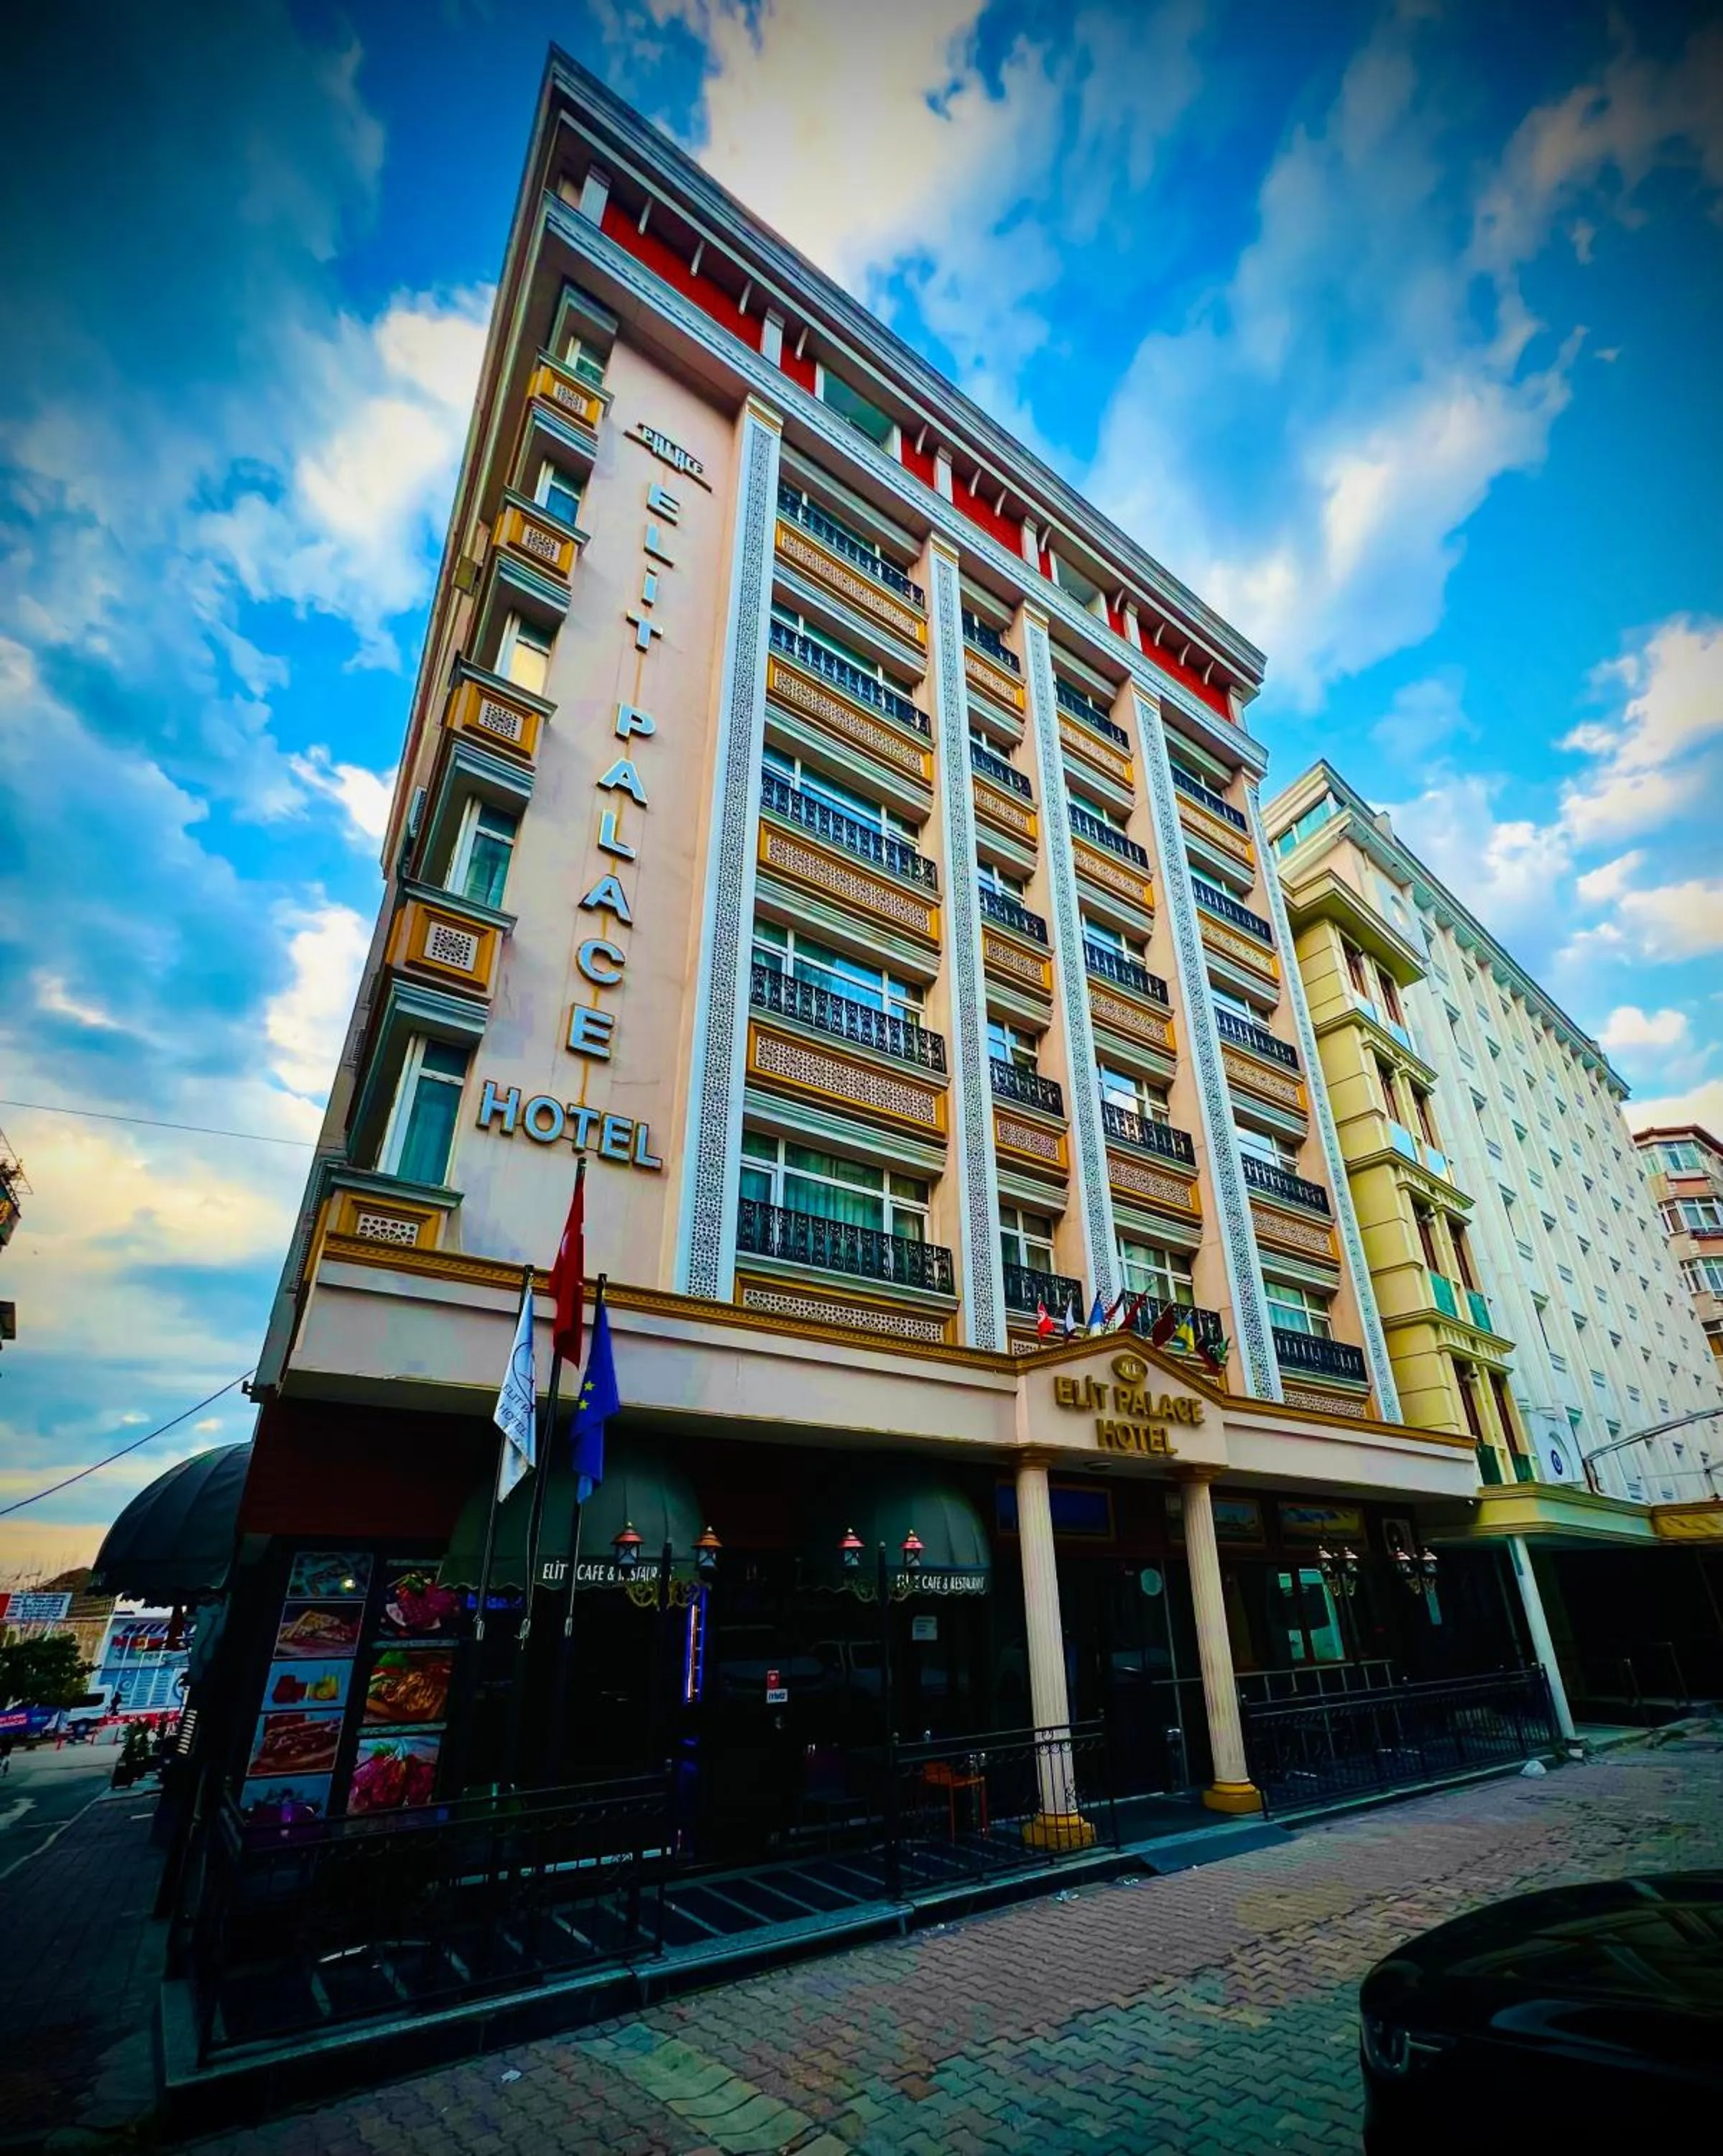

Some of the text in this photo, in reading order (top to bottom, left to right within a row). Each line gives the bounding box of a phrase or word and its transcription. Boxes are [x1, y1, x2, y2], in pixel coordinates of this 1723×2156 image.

[566, 701, 657, 1061] PALACE
[476, 1079, 662, 1170] HOTEL
[1114, 1386, 1205, 1424] PALACE
[1095, 1418, 1179, 1455] HOTEL
[577, 1564, 605, 1581] CAFE
[607, 1565, 614, 1581] &
